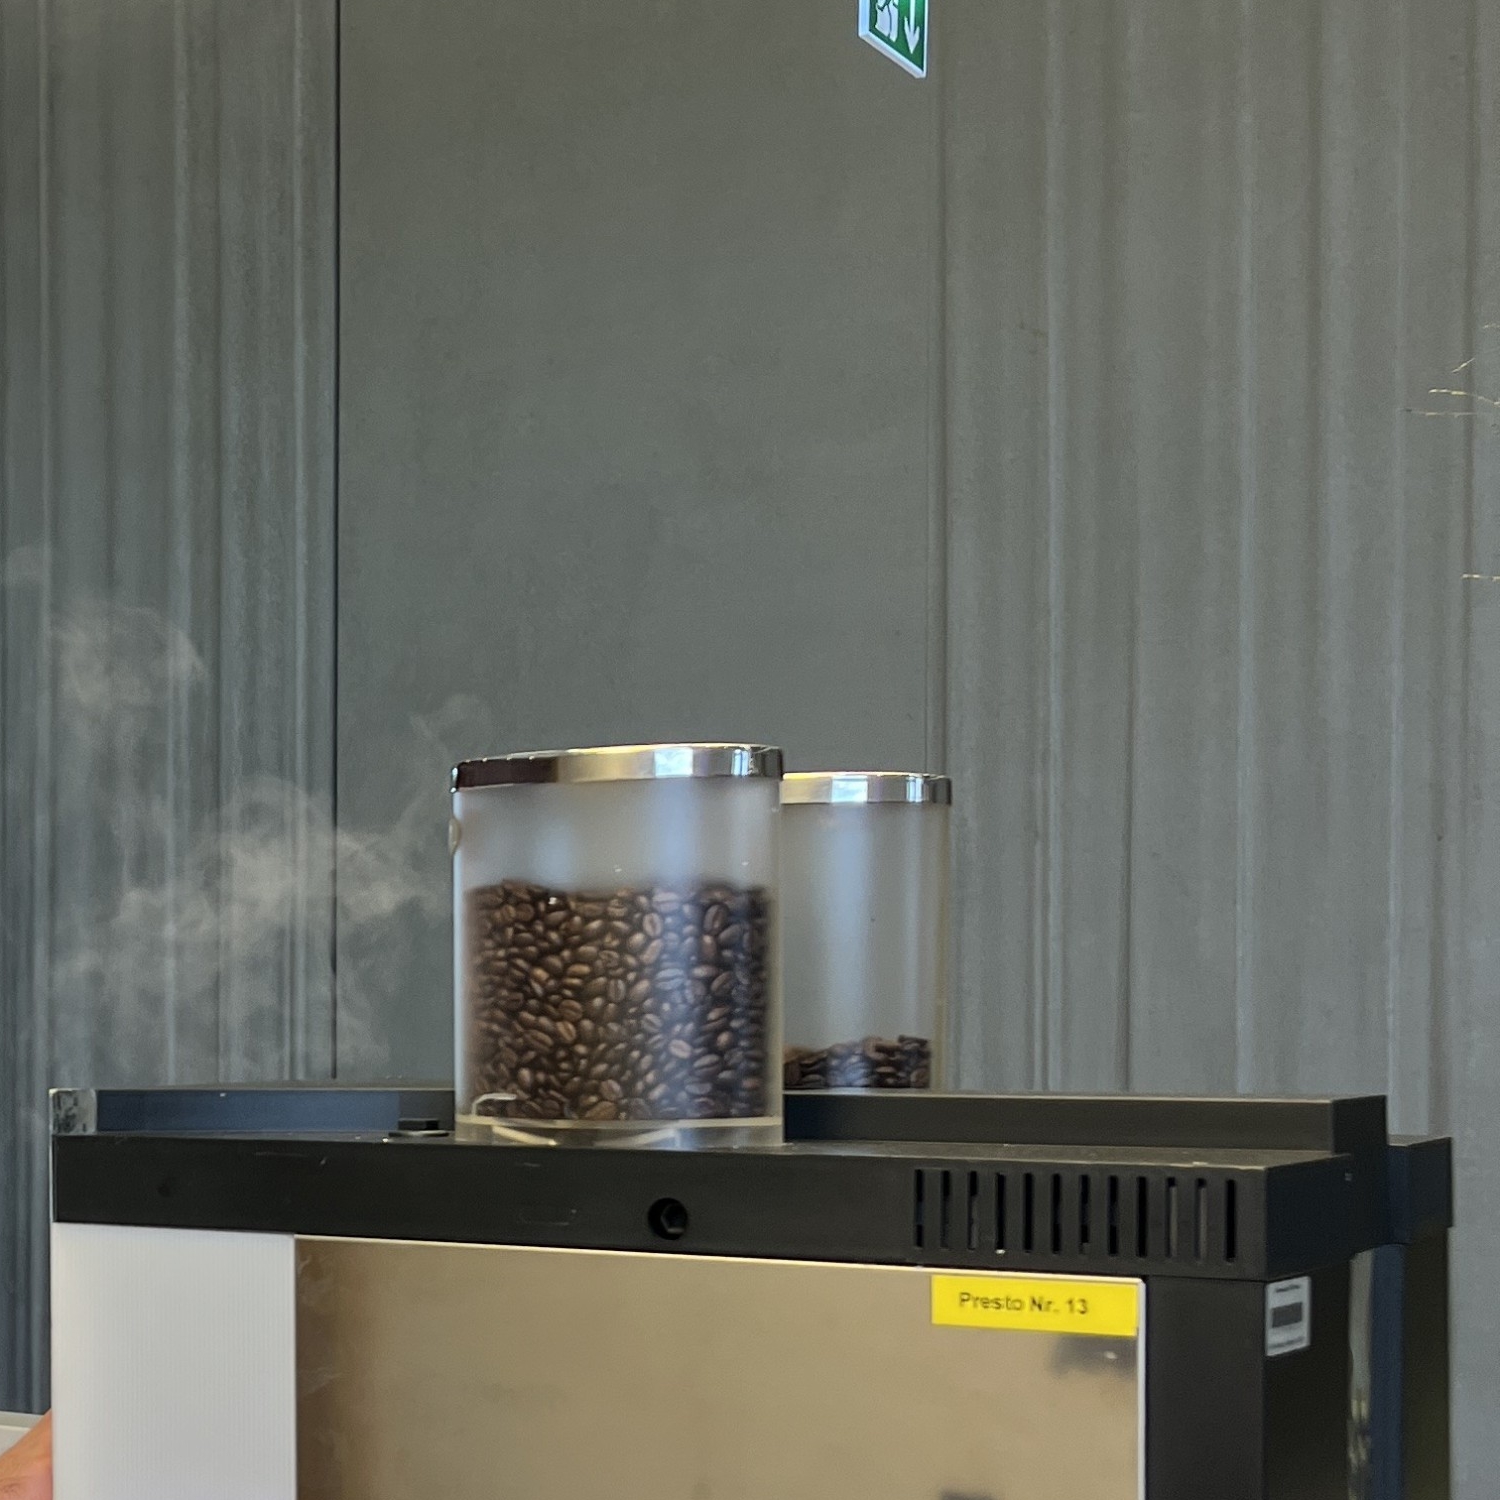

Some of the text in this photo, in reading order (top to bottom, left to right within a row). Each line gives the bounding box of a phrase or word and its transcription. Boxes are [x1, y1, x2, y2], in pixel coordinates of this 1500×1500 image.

[958, 1291, 1089, 1315] Presto Nr. 13
